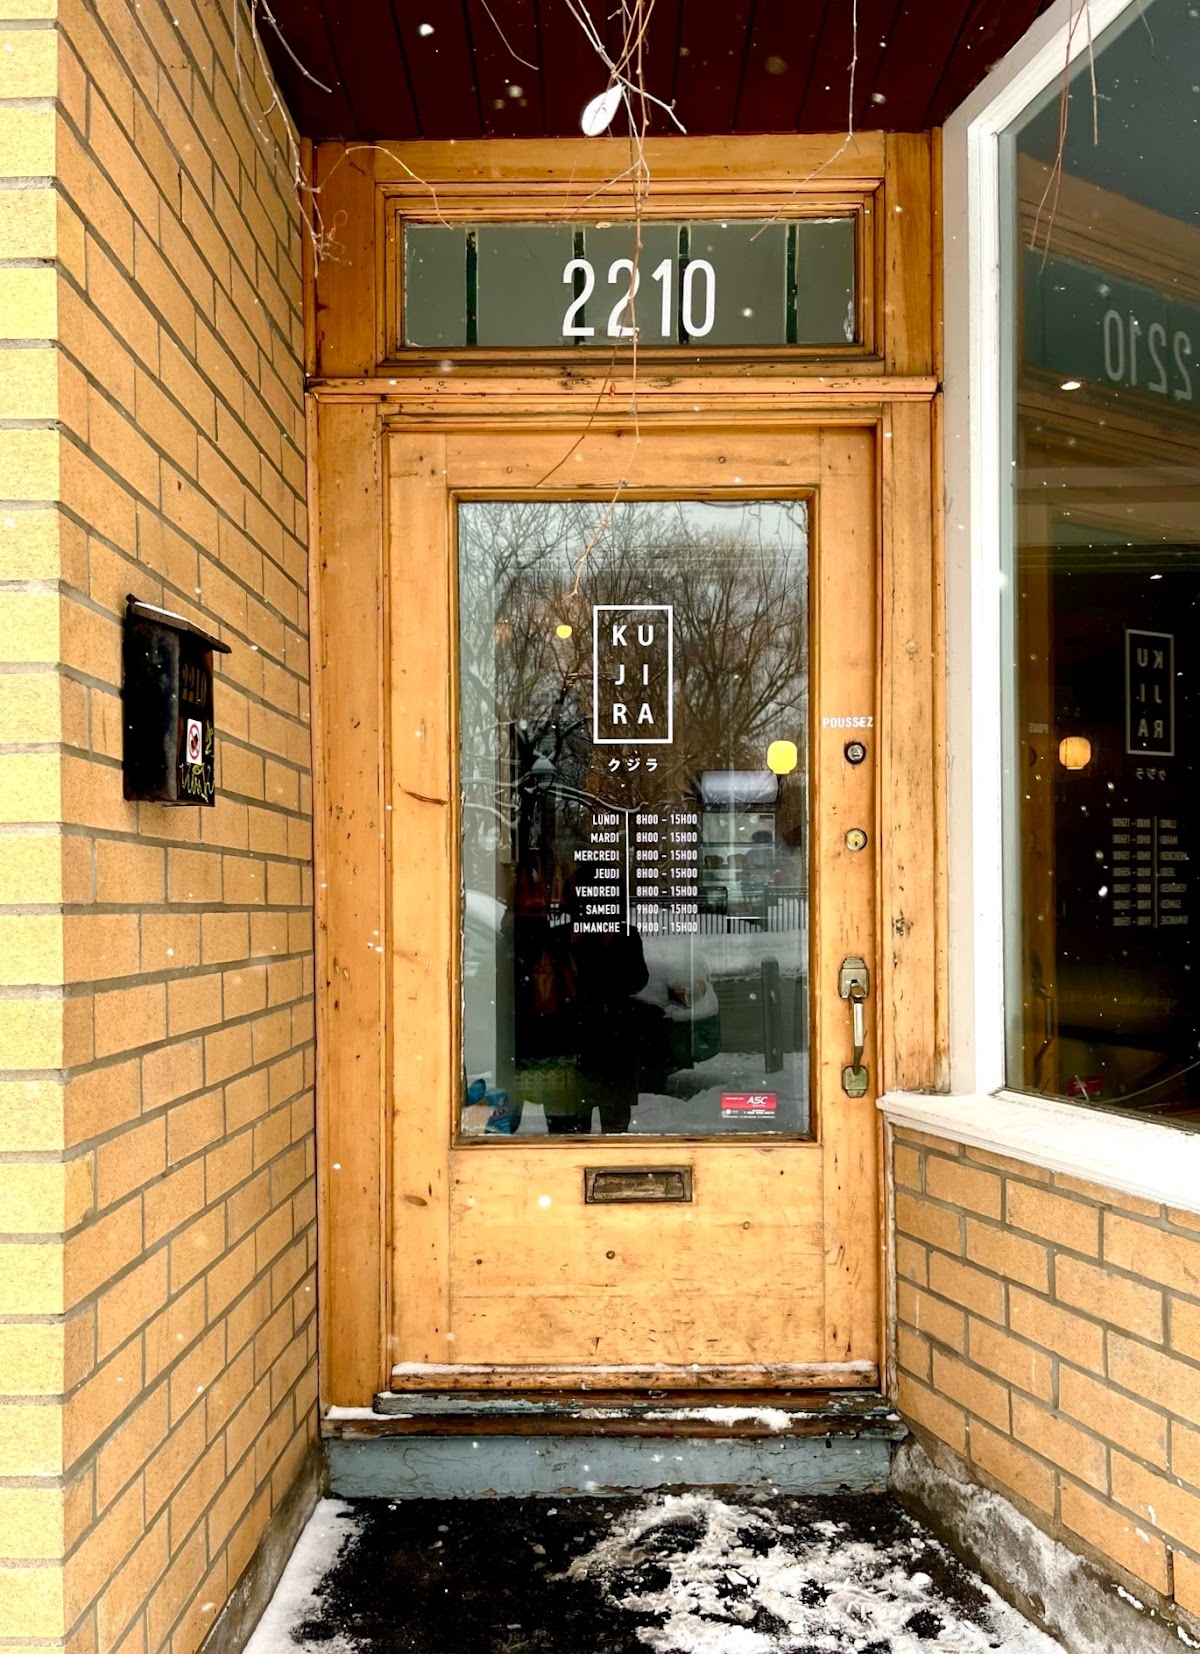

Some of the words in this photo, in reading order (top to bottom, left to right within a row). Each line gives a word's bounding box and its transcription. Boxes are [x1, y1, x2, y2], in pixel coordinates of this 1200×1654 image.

[562, 258, 716, 337] 2210
[823, 717, 873, 728] POUSSEZ
[608, 758, 658, 772] クジラ
[592, 813, 620, 825] LUNDI
[636, 813, 659, 825] 8H00
[670, 813, 698, 825] 15H00
[590, 832, 620, 843] MARDI
[636, 832, 659, 843] 8H00
[670, 832, 698, 843] 15H00
[574, 850, 620, 861] MERCREDI
[636, 850, 659, 861] 8H00
[670, 850, 698, 861] 15H00
[594, 868, 620, 879] JEUDI
[636, 868, 659, 879] 8H00
[670, 868, 698, 879] 15H00
[575, 886, 620, 897] VENDREDI
[636, 886, 659, 897] 8H00
[670, 886, 698, 897] 15H00
[586, 904, 620, 915] SAMEDI
[636, 904, 659, 915] 9H00
[670, 904, 698, 915] 15H00
[573, 922, 620, 933] DIMANCHE
[636, 922, 659, 933] 9H00
[670, 922, 698, 933] 15H00
[746, 1096, 768, 1105] ASC
